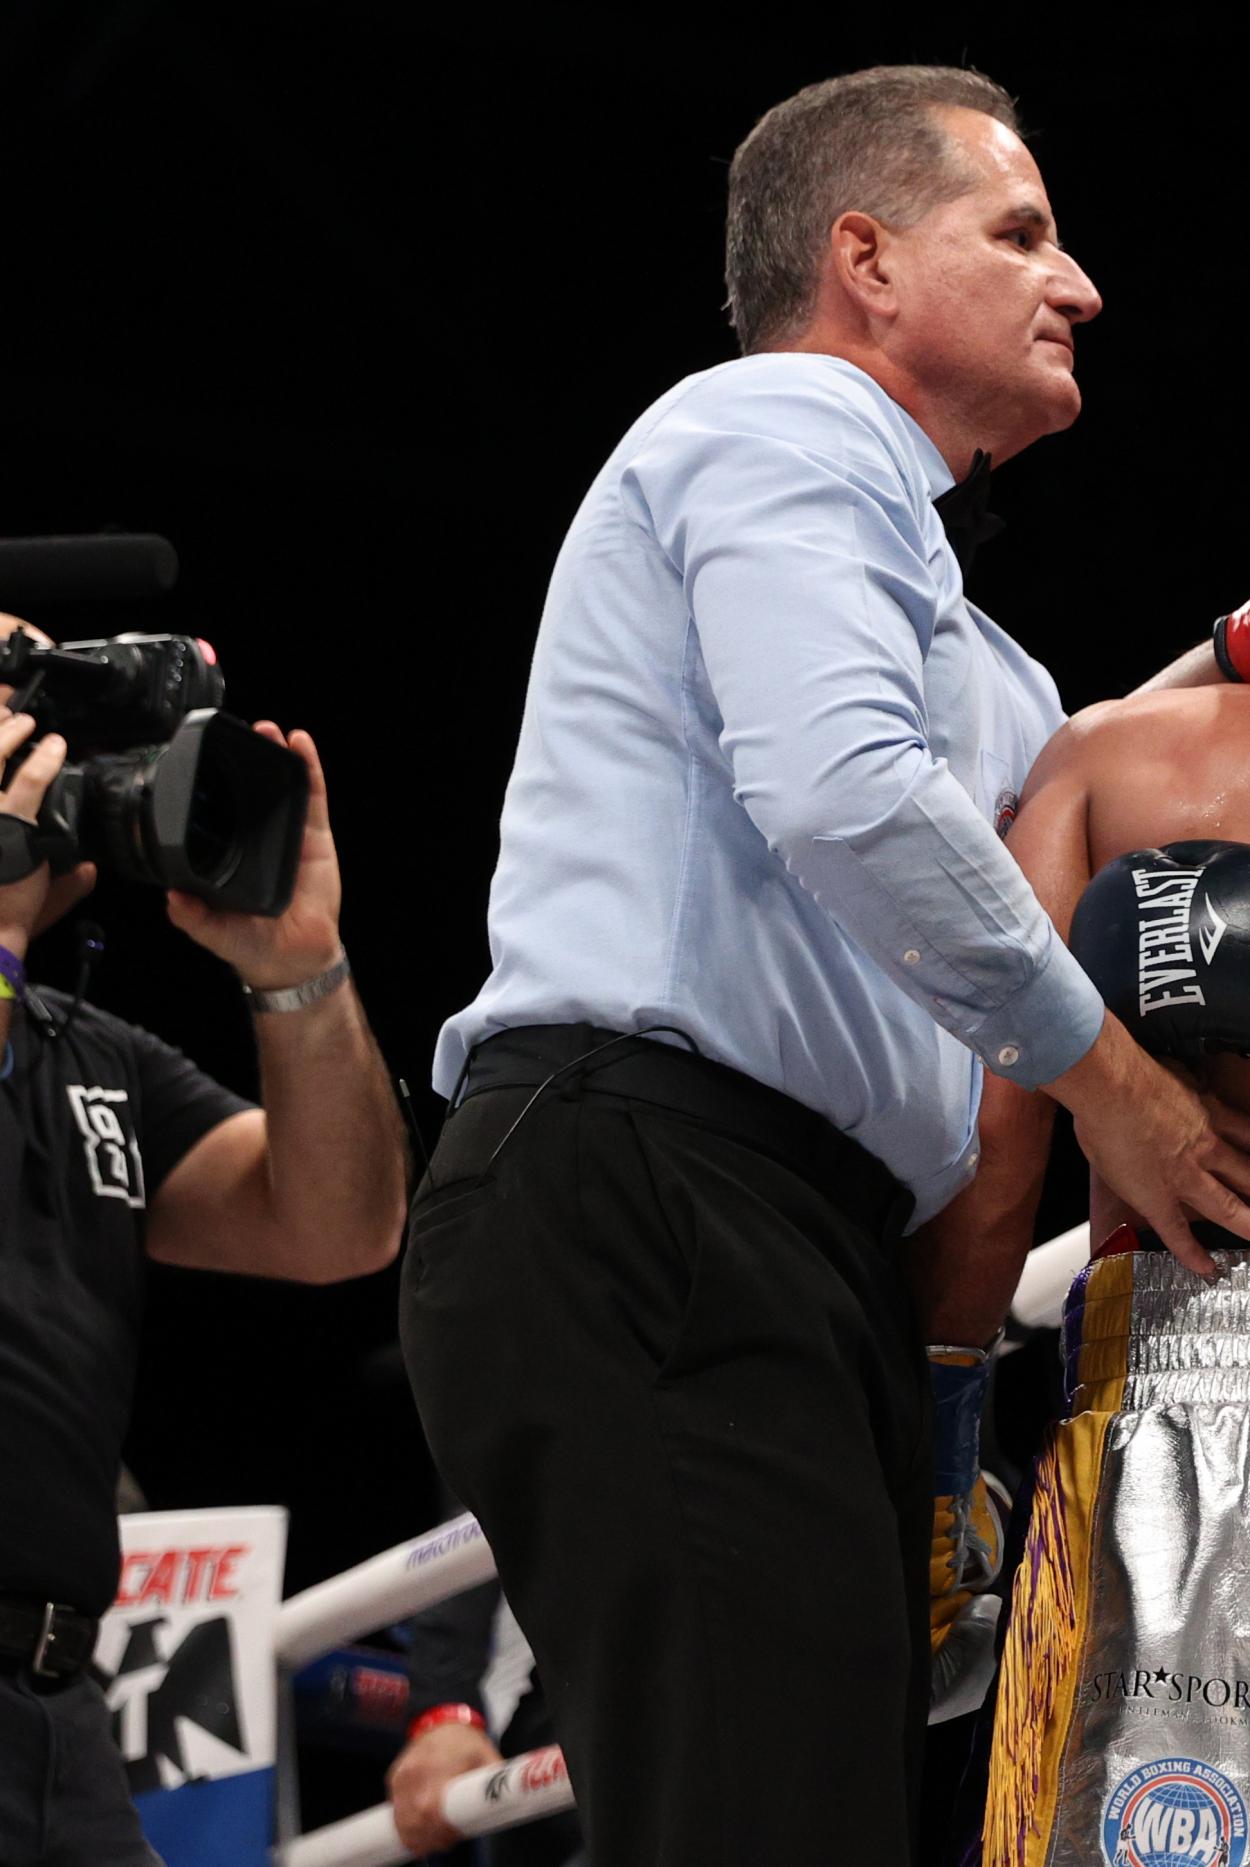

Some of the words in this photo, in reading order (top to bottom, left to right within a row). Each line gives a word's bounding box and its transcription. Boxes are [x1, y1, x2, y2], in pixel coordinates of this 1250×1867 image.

[1131, 868, 1207, 1018] EVERLAST
[1108, 1774, 1142, 1820] WORLD
[1141, 1761, 1191, 1781] BOXING
[1193, 1764, 1245, 1837] ASSOCIATION
[1133, 1796, 1217, 1866] WBA
